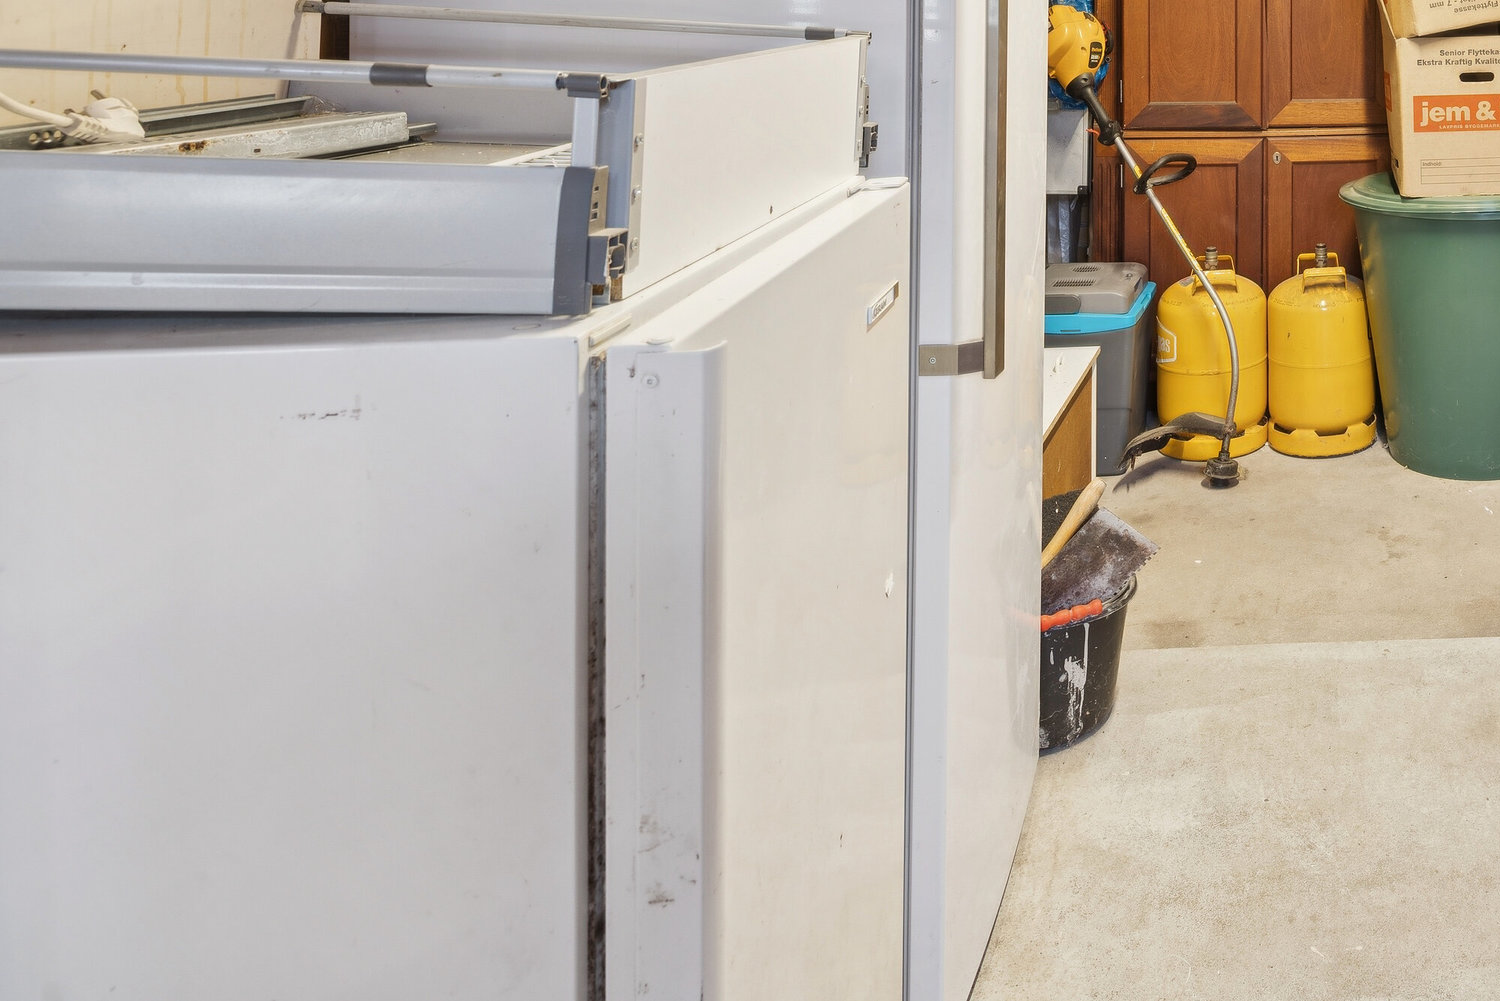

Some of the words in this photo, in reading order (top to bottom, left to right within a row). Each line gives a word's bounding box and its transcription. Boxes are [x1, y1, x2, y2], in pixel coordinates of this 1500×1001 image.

[1429, 1, 1444, 9] mm
[1454, 0, 1500, 14] Flyttekasse
[1440, 49, 1466, 57] Senior
[1445, 58, 1473, 67] Kraftig
[1420, 101, 1471, 127] jem
[1475, 100, 1496, 121] &
